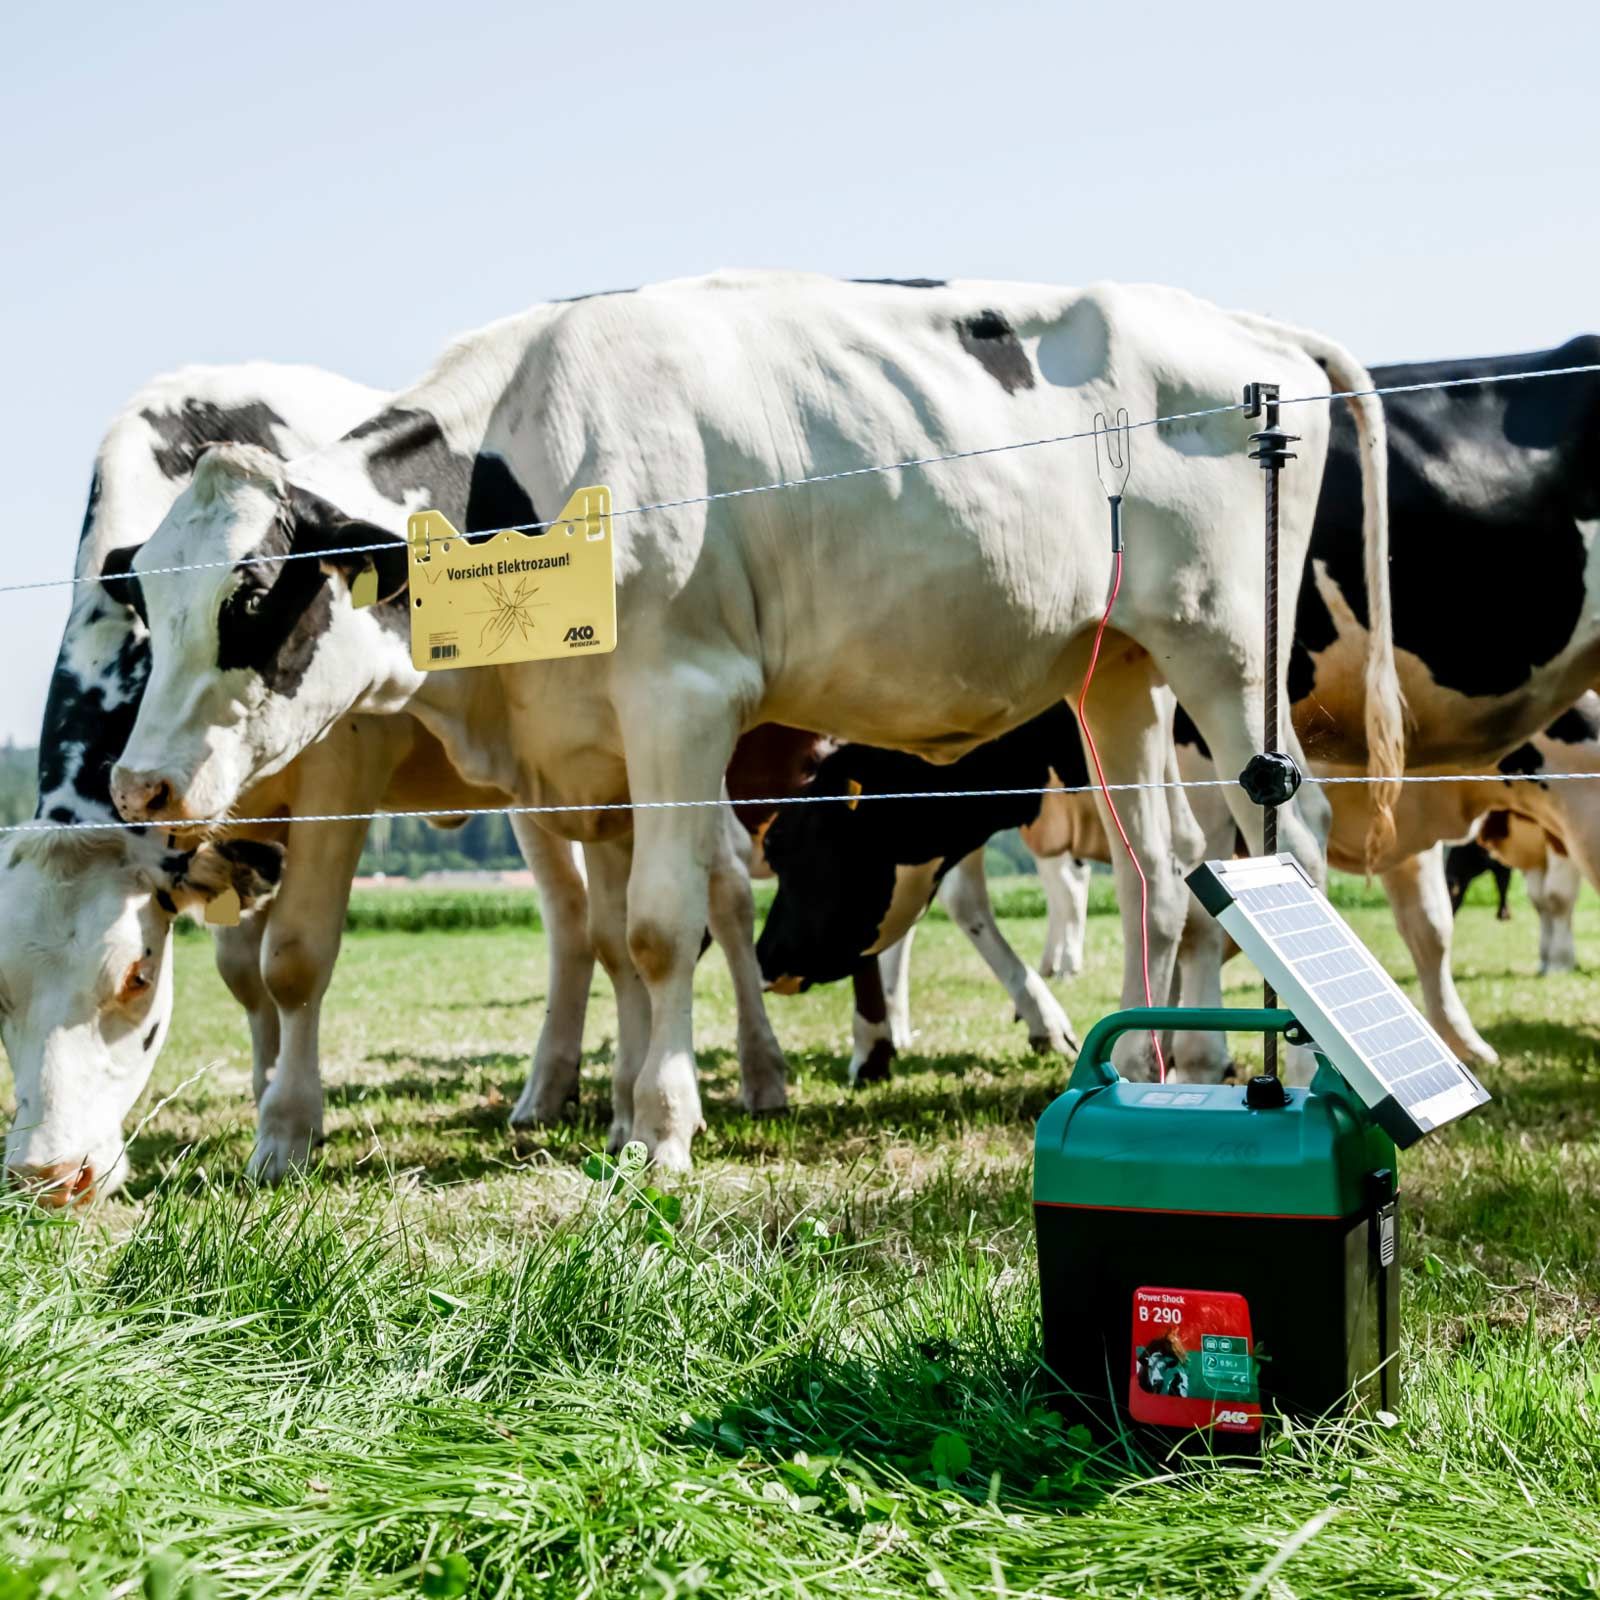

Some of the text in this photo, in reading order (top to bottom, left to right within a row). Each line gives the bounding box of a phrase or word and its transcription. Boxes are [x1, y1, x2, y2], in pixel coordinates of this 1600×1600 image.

[447, 552, 570, 581] Vorsicht Elektrozaun!
[563, 625, 594, 642] AKO
[1137, 1292, 1185, 1304] Power Shock
[1139, 1306, 1182, 1324] B 290
[1216, 1410, 1249, 1424] AKO
